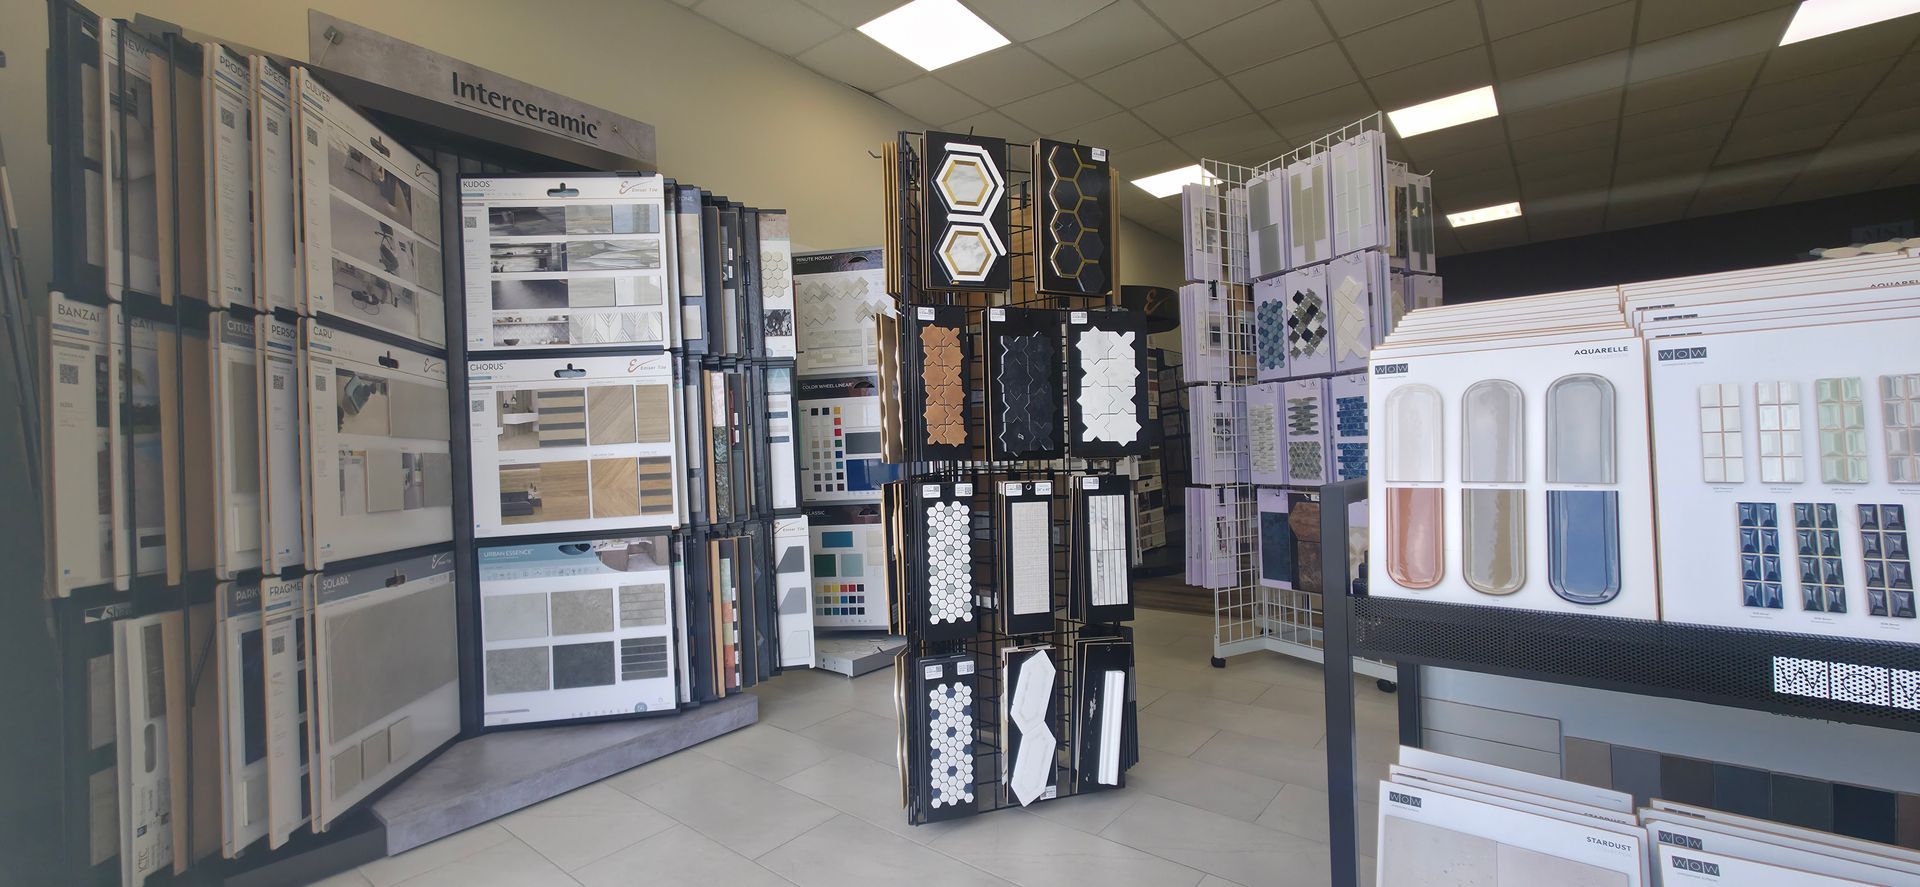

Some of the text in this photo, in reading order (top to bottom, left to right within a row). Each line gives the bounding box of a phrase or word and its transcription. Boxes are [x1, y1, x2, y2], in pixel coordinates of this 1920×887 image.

[452, 71, 598, 139] Interceramic
[313, 326, 333, 339] CARU
[1574, 346, 1629, 356] AQUARELLE
[1658, 347, 1707, 361] WOW
[1375, 363, 1409, 375] WOW
[322, 576, 349, 590] SOLARA
[1389, 792, 1421, 808] WOW
[1586, 836, 1631, 851] STARDUST
[1659, 831, 1703, 850] WOW
[1672, 856, 1720, 877] WOW
